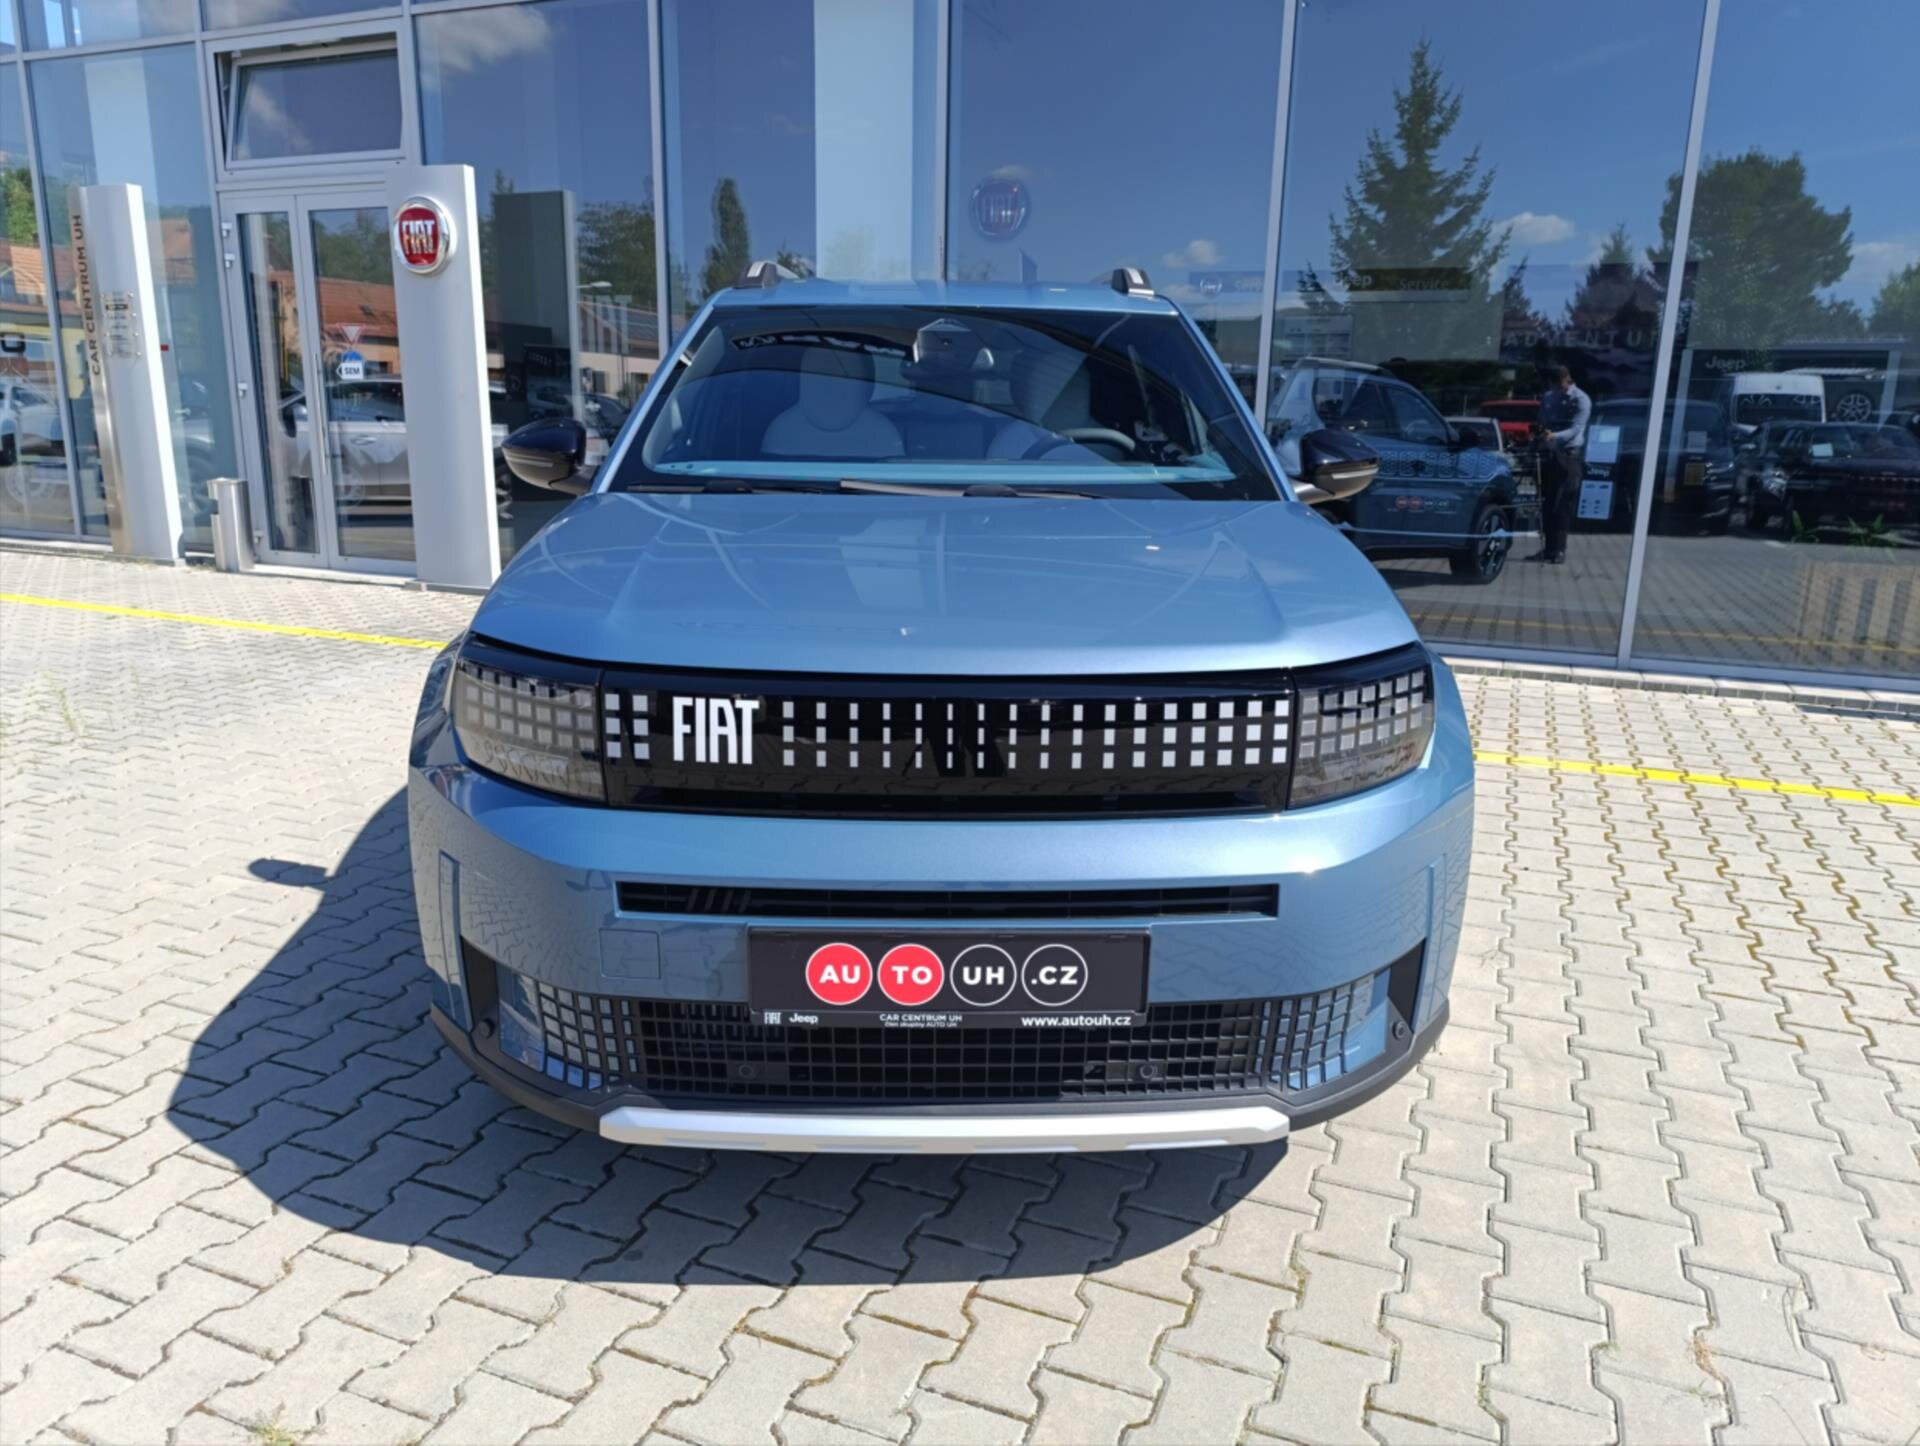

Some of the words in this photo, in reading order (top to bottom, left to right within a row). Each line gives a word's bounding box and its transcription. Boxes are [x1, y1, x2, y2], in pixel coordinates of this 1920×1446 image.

[72, 214, 84, 240] UH
[402, 220, 435, 254] FIAT
[76, 246, 95, 333] CENTRUM
[89, 339, 101, 376] CAR
[1705, 354, 1747, 371] Jeep
[672, 696, 760, 765] FIAT
[819, 964, 861, 984] AU
[891, 965, 933, 985] TO
[962, 966, 1005, 986] UH
[1031, 966, 1078, 986] .CZ
[764, 1011, 782, 1025] FIAT
[789, 1013, 819, 1025] Jeep
[880, 1013, 900, 1022] CAR
[901, 1013, 947, 1022] CENTRUM
[948, 1013, 963, 1022] UH
[1021, 1014, 1132, 1028] www.autouh.cz
